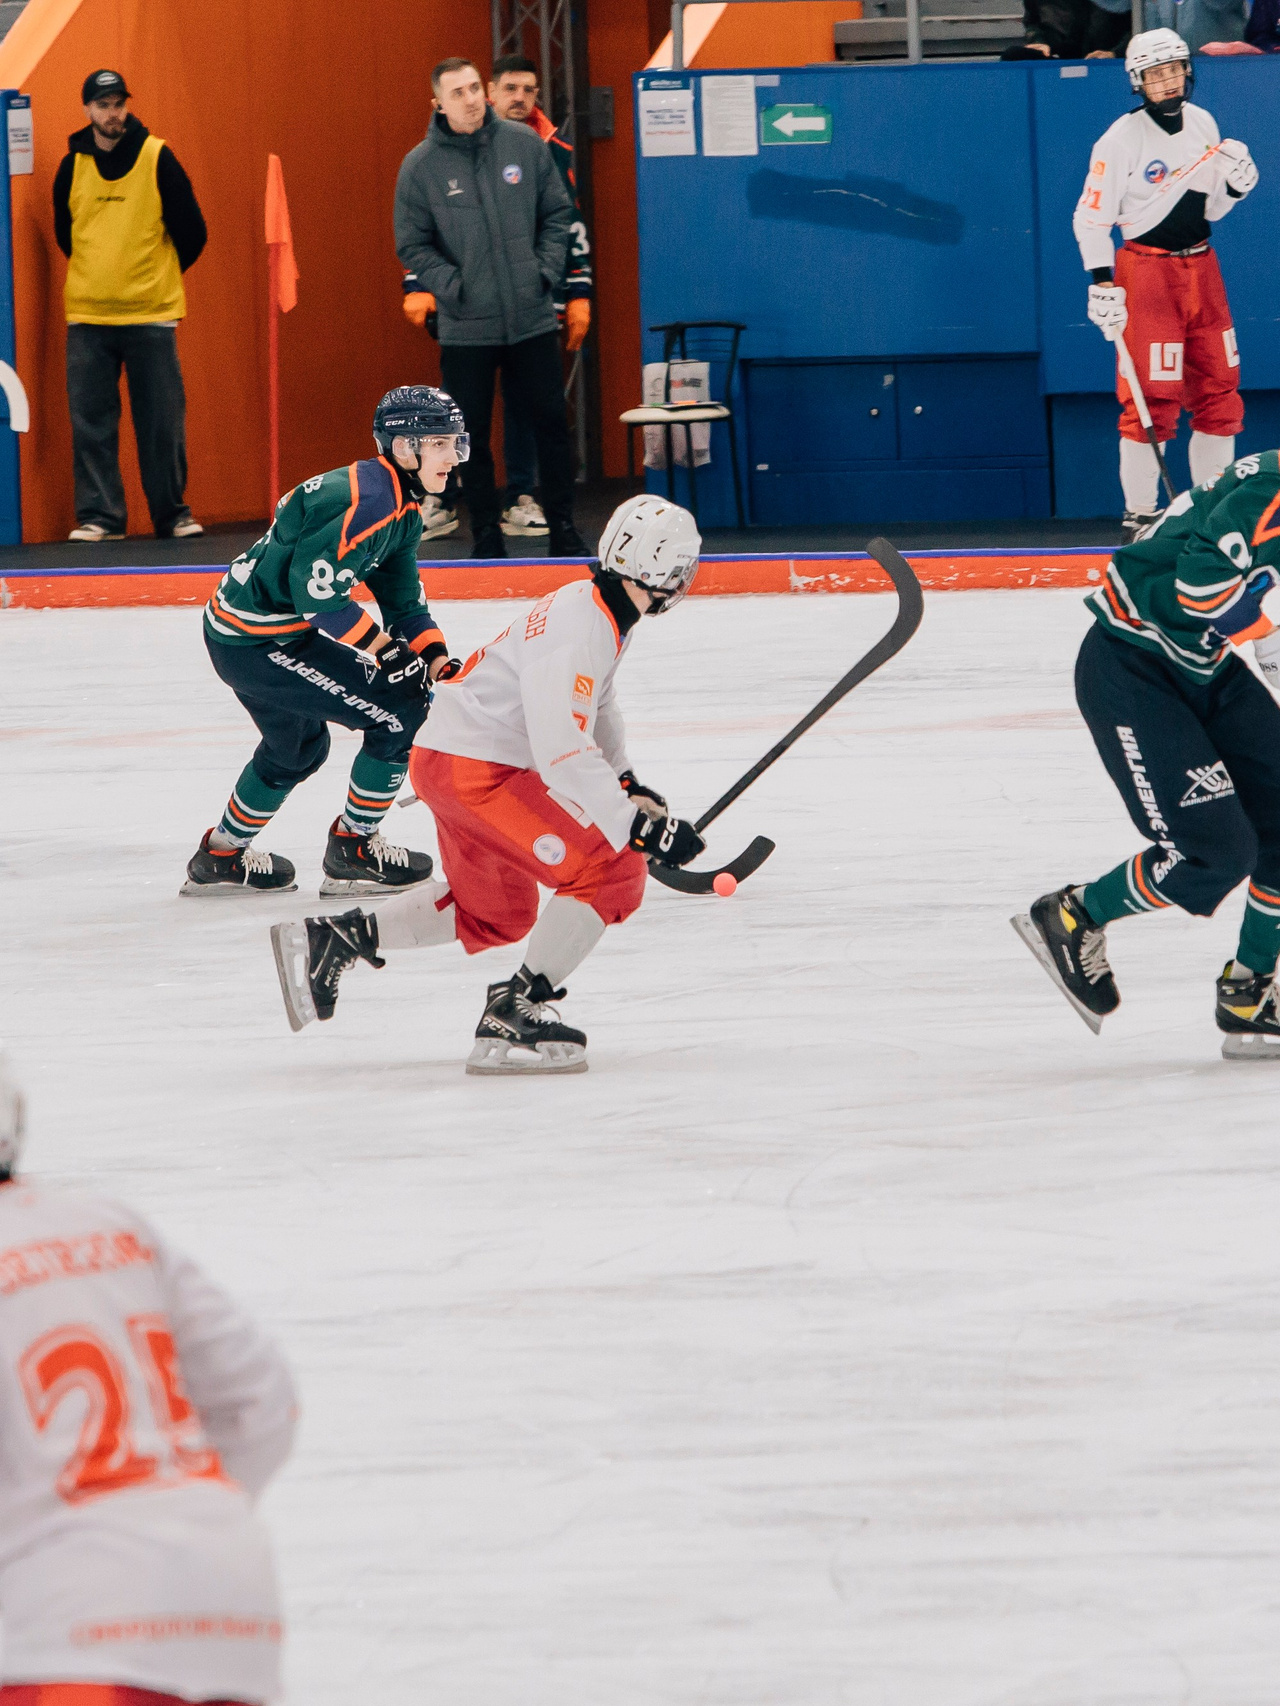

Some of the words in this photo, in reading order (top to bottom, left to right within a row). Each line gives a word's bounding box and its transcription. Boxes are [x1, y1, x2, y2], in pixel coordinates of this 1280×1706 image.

[385, 419, 405, 427] CCM
[618, 532, 634, 552] 7
[659, 817, 679, 853] CC
